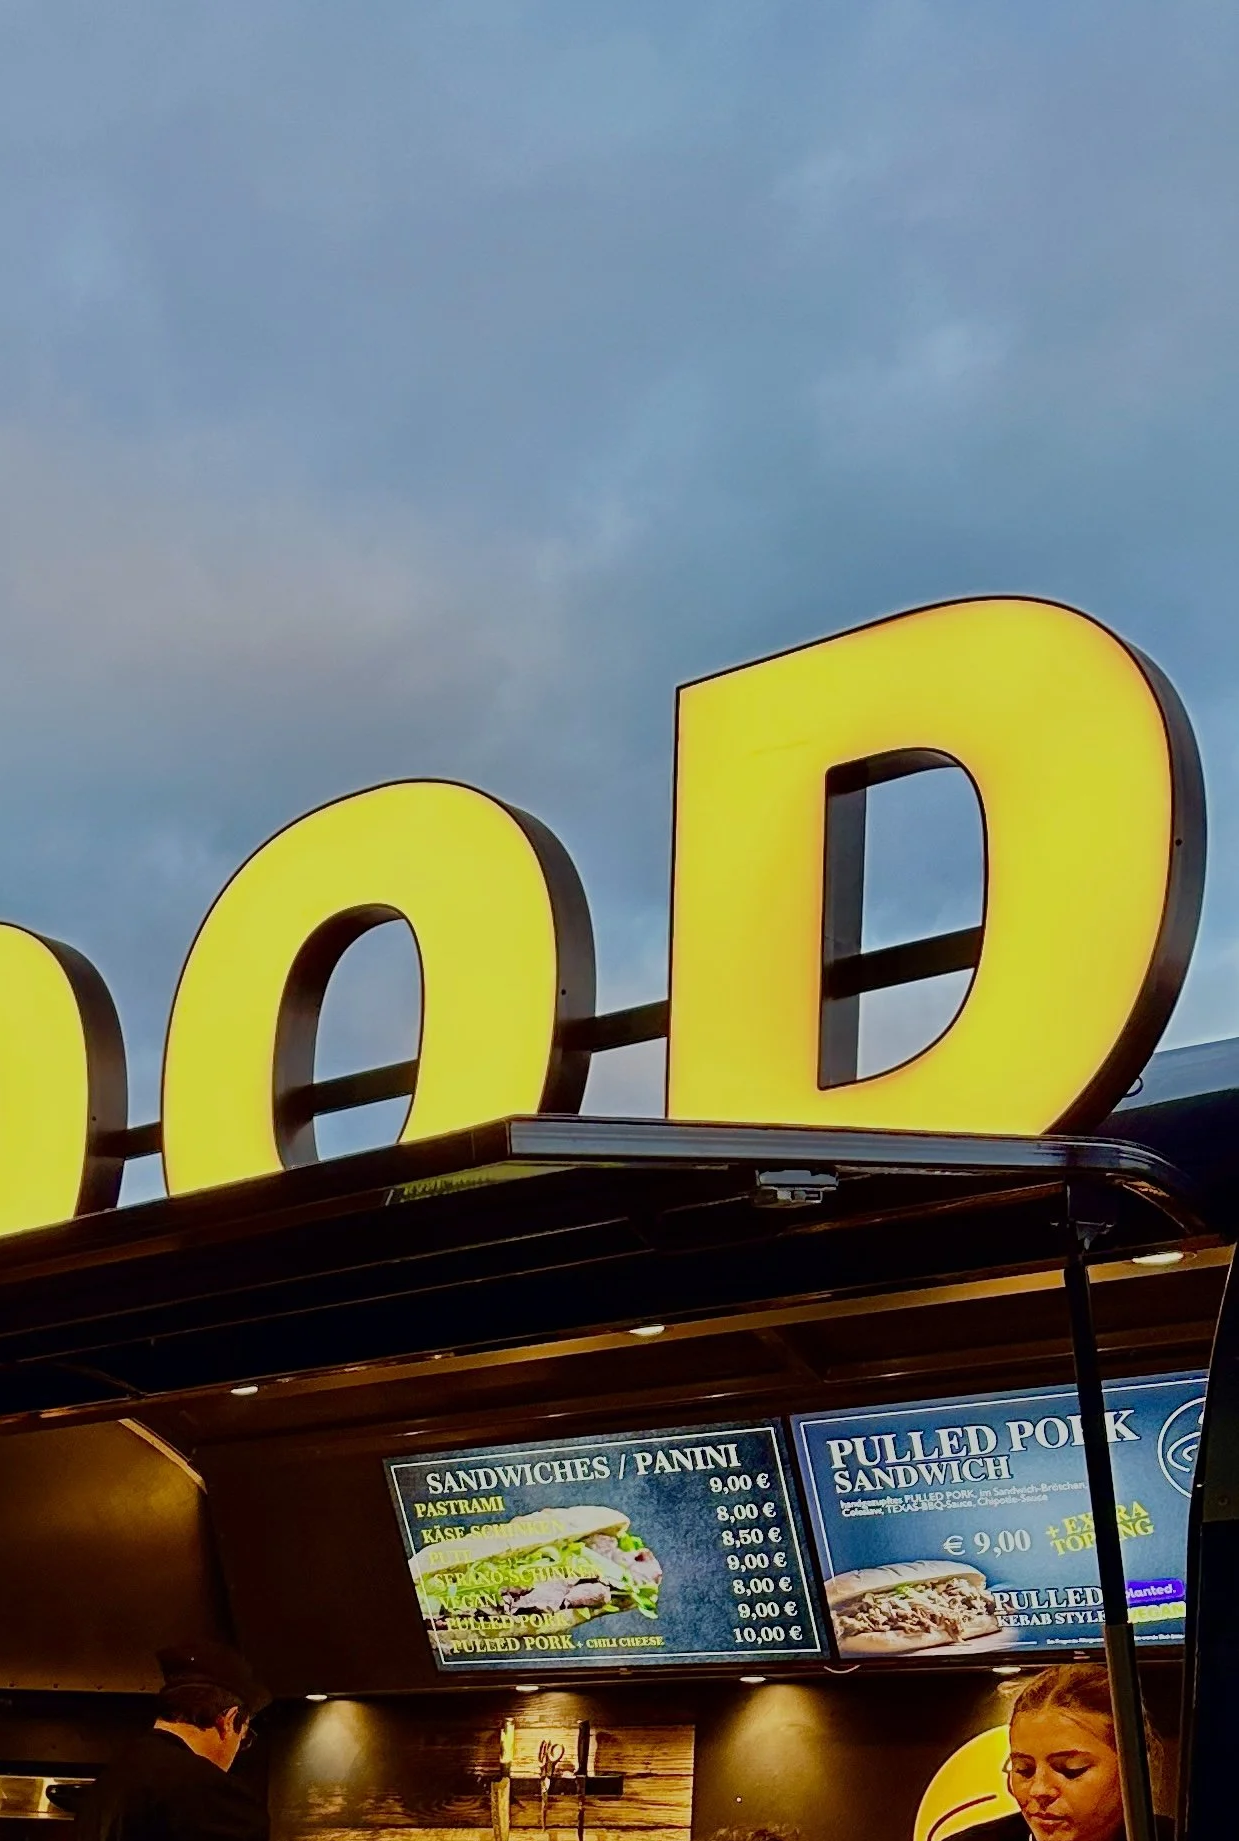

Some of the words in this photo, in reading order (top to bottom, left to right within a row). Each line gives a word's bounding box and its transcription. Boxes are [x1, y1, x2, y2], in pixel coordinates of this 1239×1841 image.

[827, 1425, 998, 1469] PULLED
[426, 1456, 610, 1494] SANDWICHES
[633, 1443, 742, 1475] PANINI
[834, 1455, 1013, 1494] SANDWICH
[709, 1474, 753, 1494] 9,00
[756, 1473, 771, 1489] €
[414, 1496, 505, 1518] PASTRAMI
[716, 1503, 759, 1524] 8,00
[762, 1502, 777, 1518] €
[1063, 1501, 1149, 1535] EXRA
[721, 1528, 764, 1548] 8,50
[767, 1527, 782, 1543] €
[943, 1534, 966, 1556] €
[973, 1529, 1032, 1558] 9,00
[1050, 1518, 1155, 1557] TOPNG
[726, 1553, 770, 1573] 9,00
[773, 1552, 787, 1568] €
[733, 1578, 775, 1597] 8,00
[779, 1577, 793, 1592] €
[438, 1592, 498, 1611] VEGAN
[737, 1602, 780, 1620] 9,00
[783, 1601, 798, 1617] €
[993, 1587, 1104, 1616] PULLED
[445, 1616, 518, 1633] PULLED
[518, 1611, 569, 1629] PORK
[997, 1612, 1054, 1627] KEBAB
[1055, 1609, 1106, 1625] STYLE
[450, 1638, 521, 1655] PULLED
[522, 1634, 576, 1651] PORK
[585, 1638, 618, 1648] CHILI
[618, 1636, 665, 1647] CHEESE
[733, 1625, 786, 1645] 10,00
[789, 1625, 803, 1641] €
